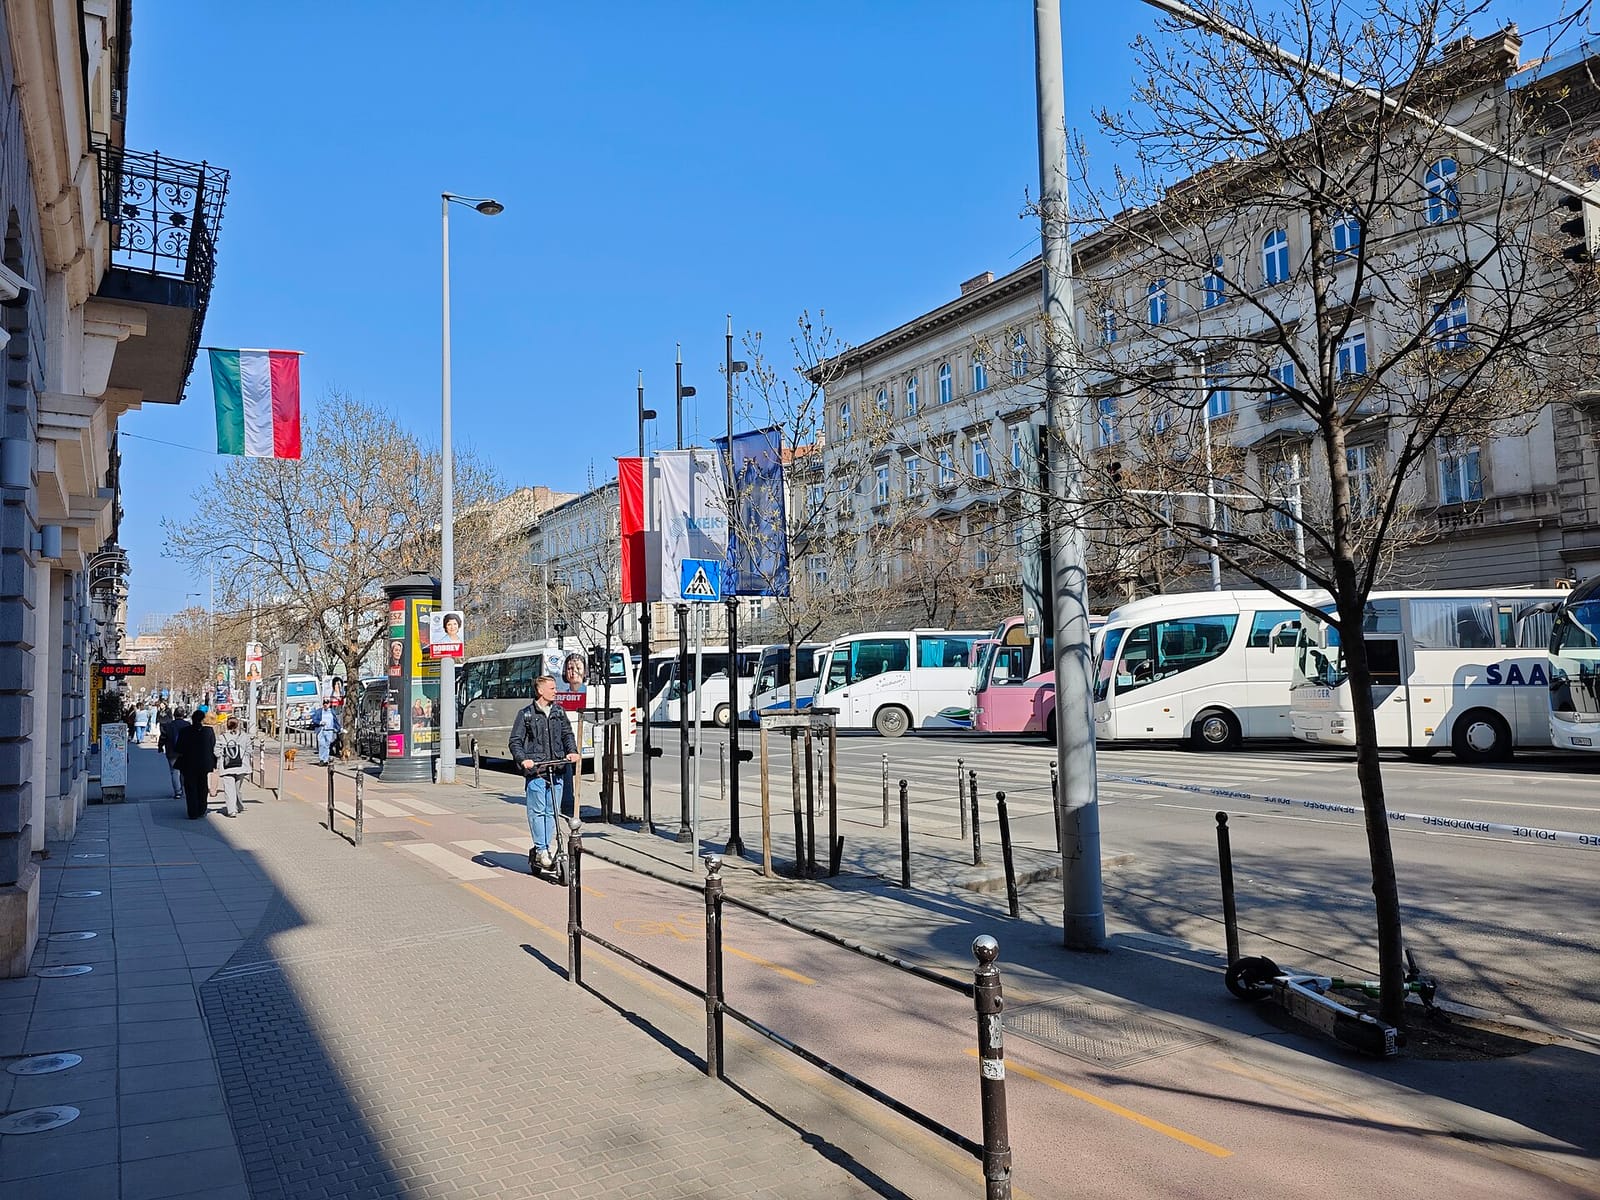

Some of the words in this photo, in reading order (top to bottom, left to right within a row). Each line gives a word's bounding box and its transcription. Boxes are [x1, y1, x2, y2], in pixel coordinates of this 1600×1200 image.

[115, 666, 131, 674] CHF
[1486, 664, 1549, 685] SAA
[1512, 827, 1556, 841] POLICE
